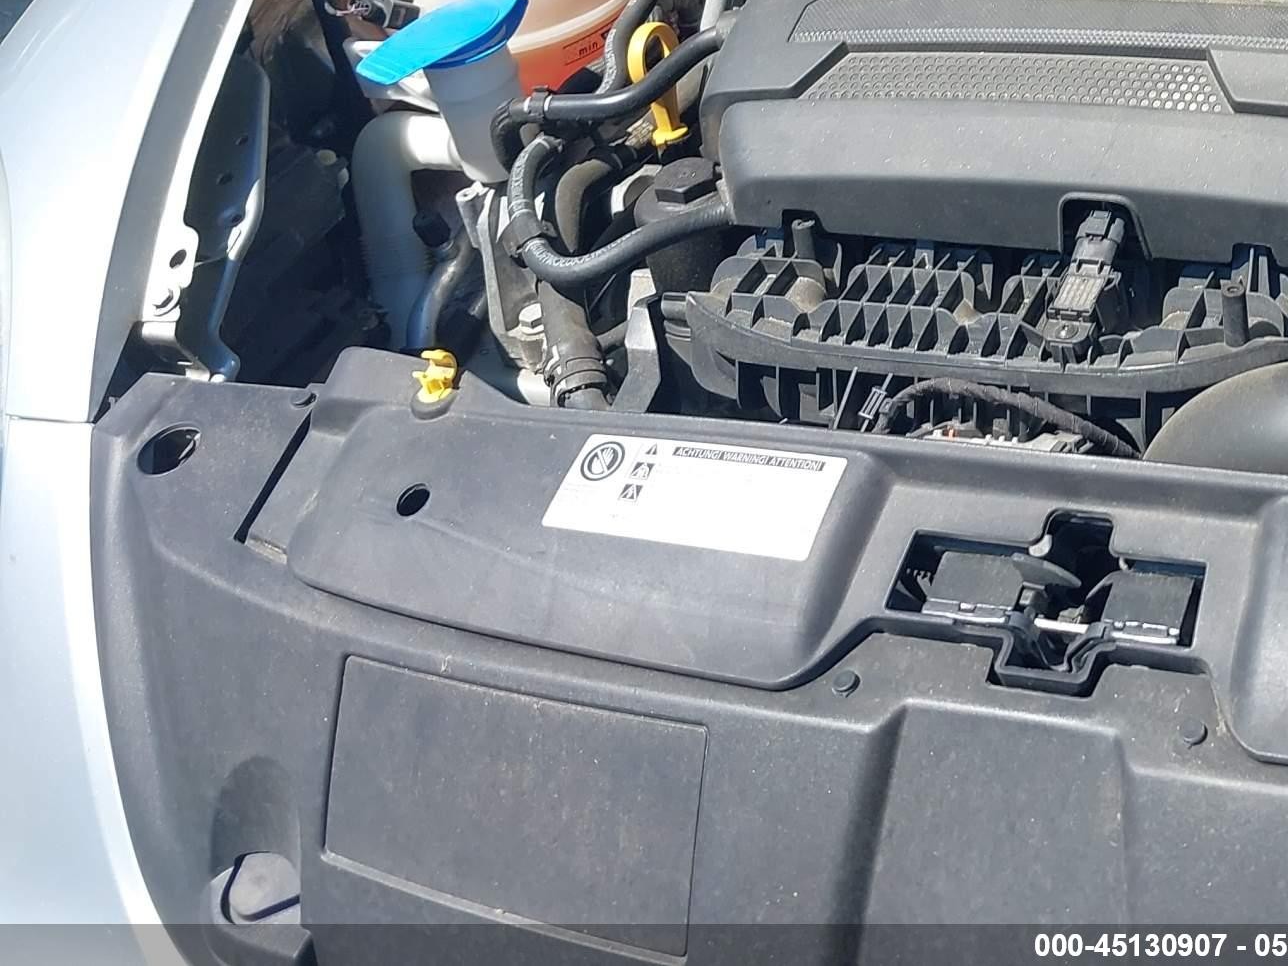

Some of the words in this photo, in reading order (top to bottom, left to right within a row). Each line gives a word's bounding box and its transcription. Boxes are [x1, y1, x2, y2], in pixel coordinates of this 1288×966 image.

[578, 41, 598, 55] min
[676, 446, 722, 461] ACHTUNG!
[723, 450, 769, 465] WARNING!
[770, 455, 822, 471] ATTENTION!
